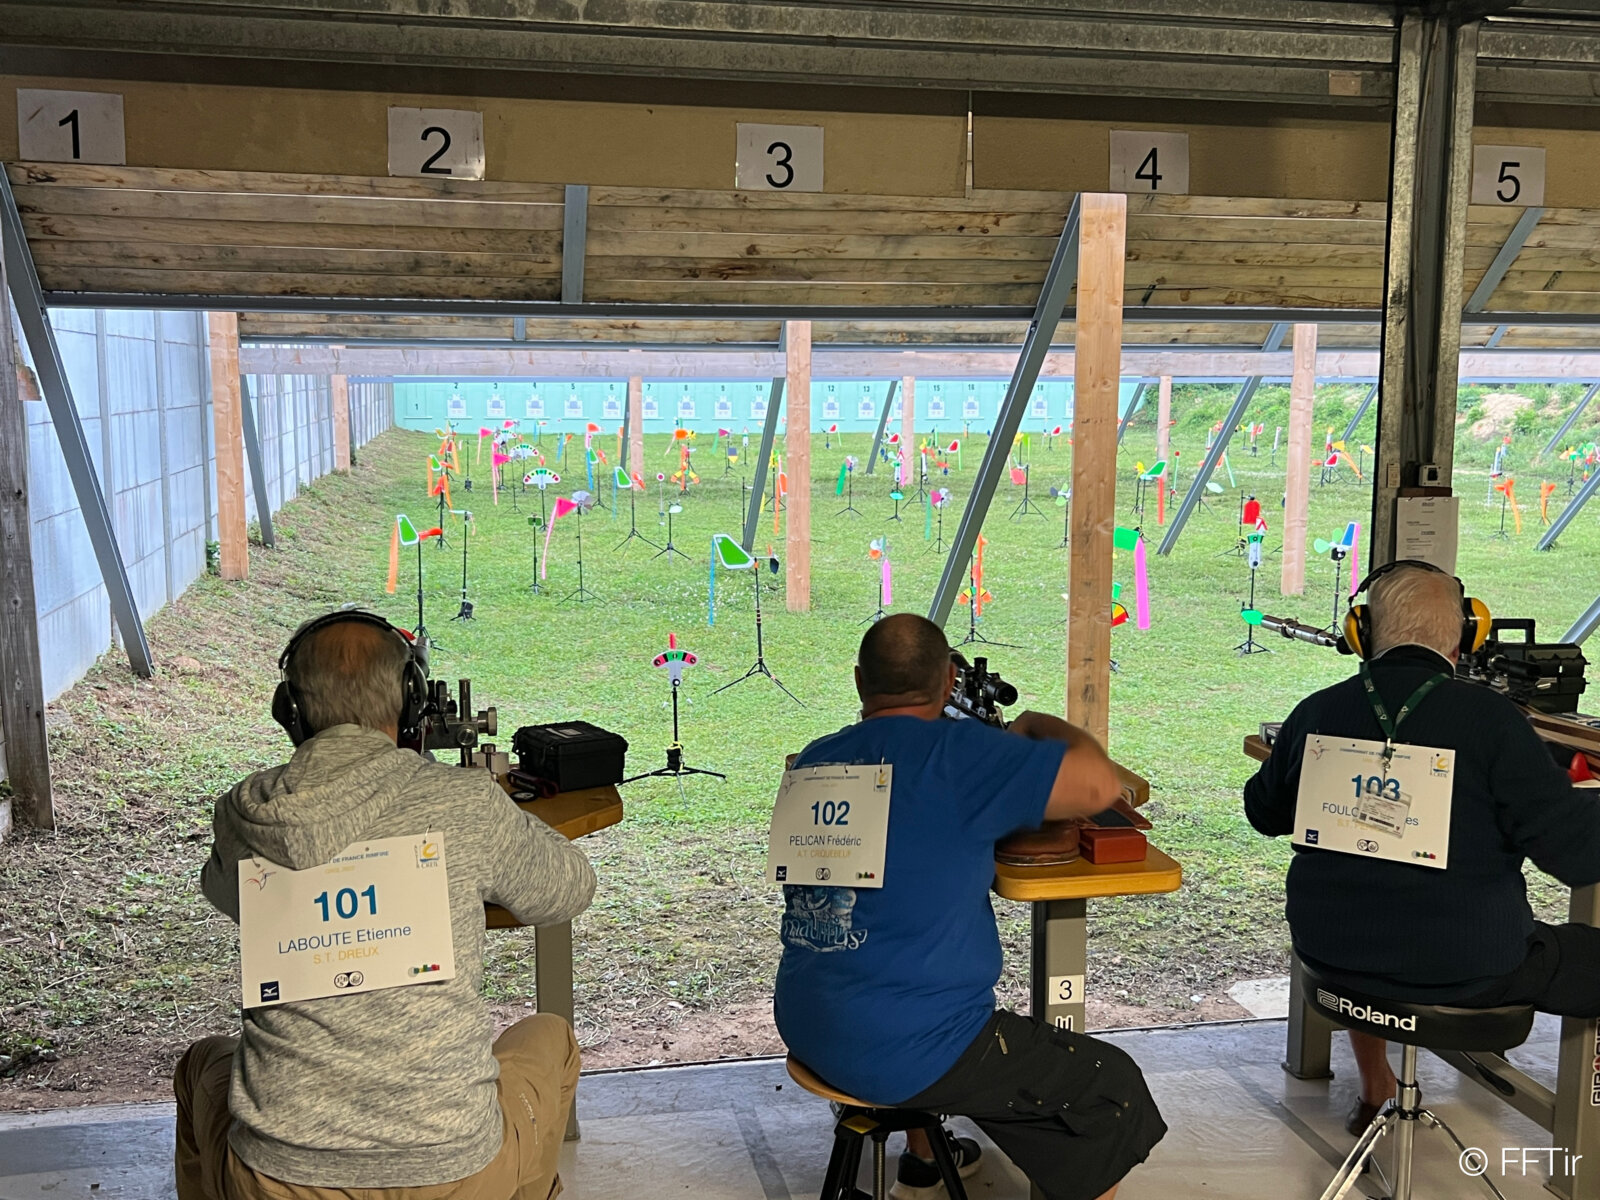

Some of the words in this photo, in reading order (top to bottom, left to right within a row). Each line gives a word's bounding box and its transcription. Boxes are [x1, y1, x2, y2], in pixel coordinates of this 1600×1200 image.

[58, 109, 82, 160] 1
[420, 126, 453, 175] 2
[766, 141, 795, 189] 3
[1134, 147, 1163, 190] 4
[1496, 161, 1521, 203] 5
[1351, 774, 1401, 802] 103
[811, 800, 851, 826] 102
[789, 835, 825, 846] PELICAN
[827, 833, 862, 846] Frédéric
[341, 854, 365, 862] FRANCE
[313, 884, 377, 922] 101
[278, 931, 352, 954] LABOUTE
[356, 926, 412, 943] Etienne
[338, 946, 380, 961] DREUX
[1059, 979, 1072, 1000] 3
[1339, 997, 1416, 1032] Roland
